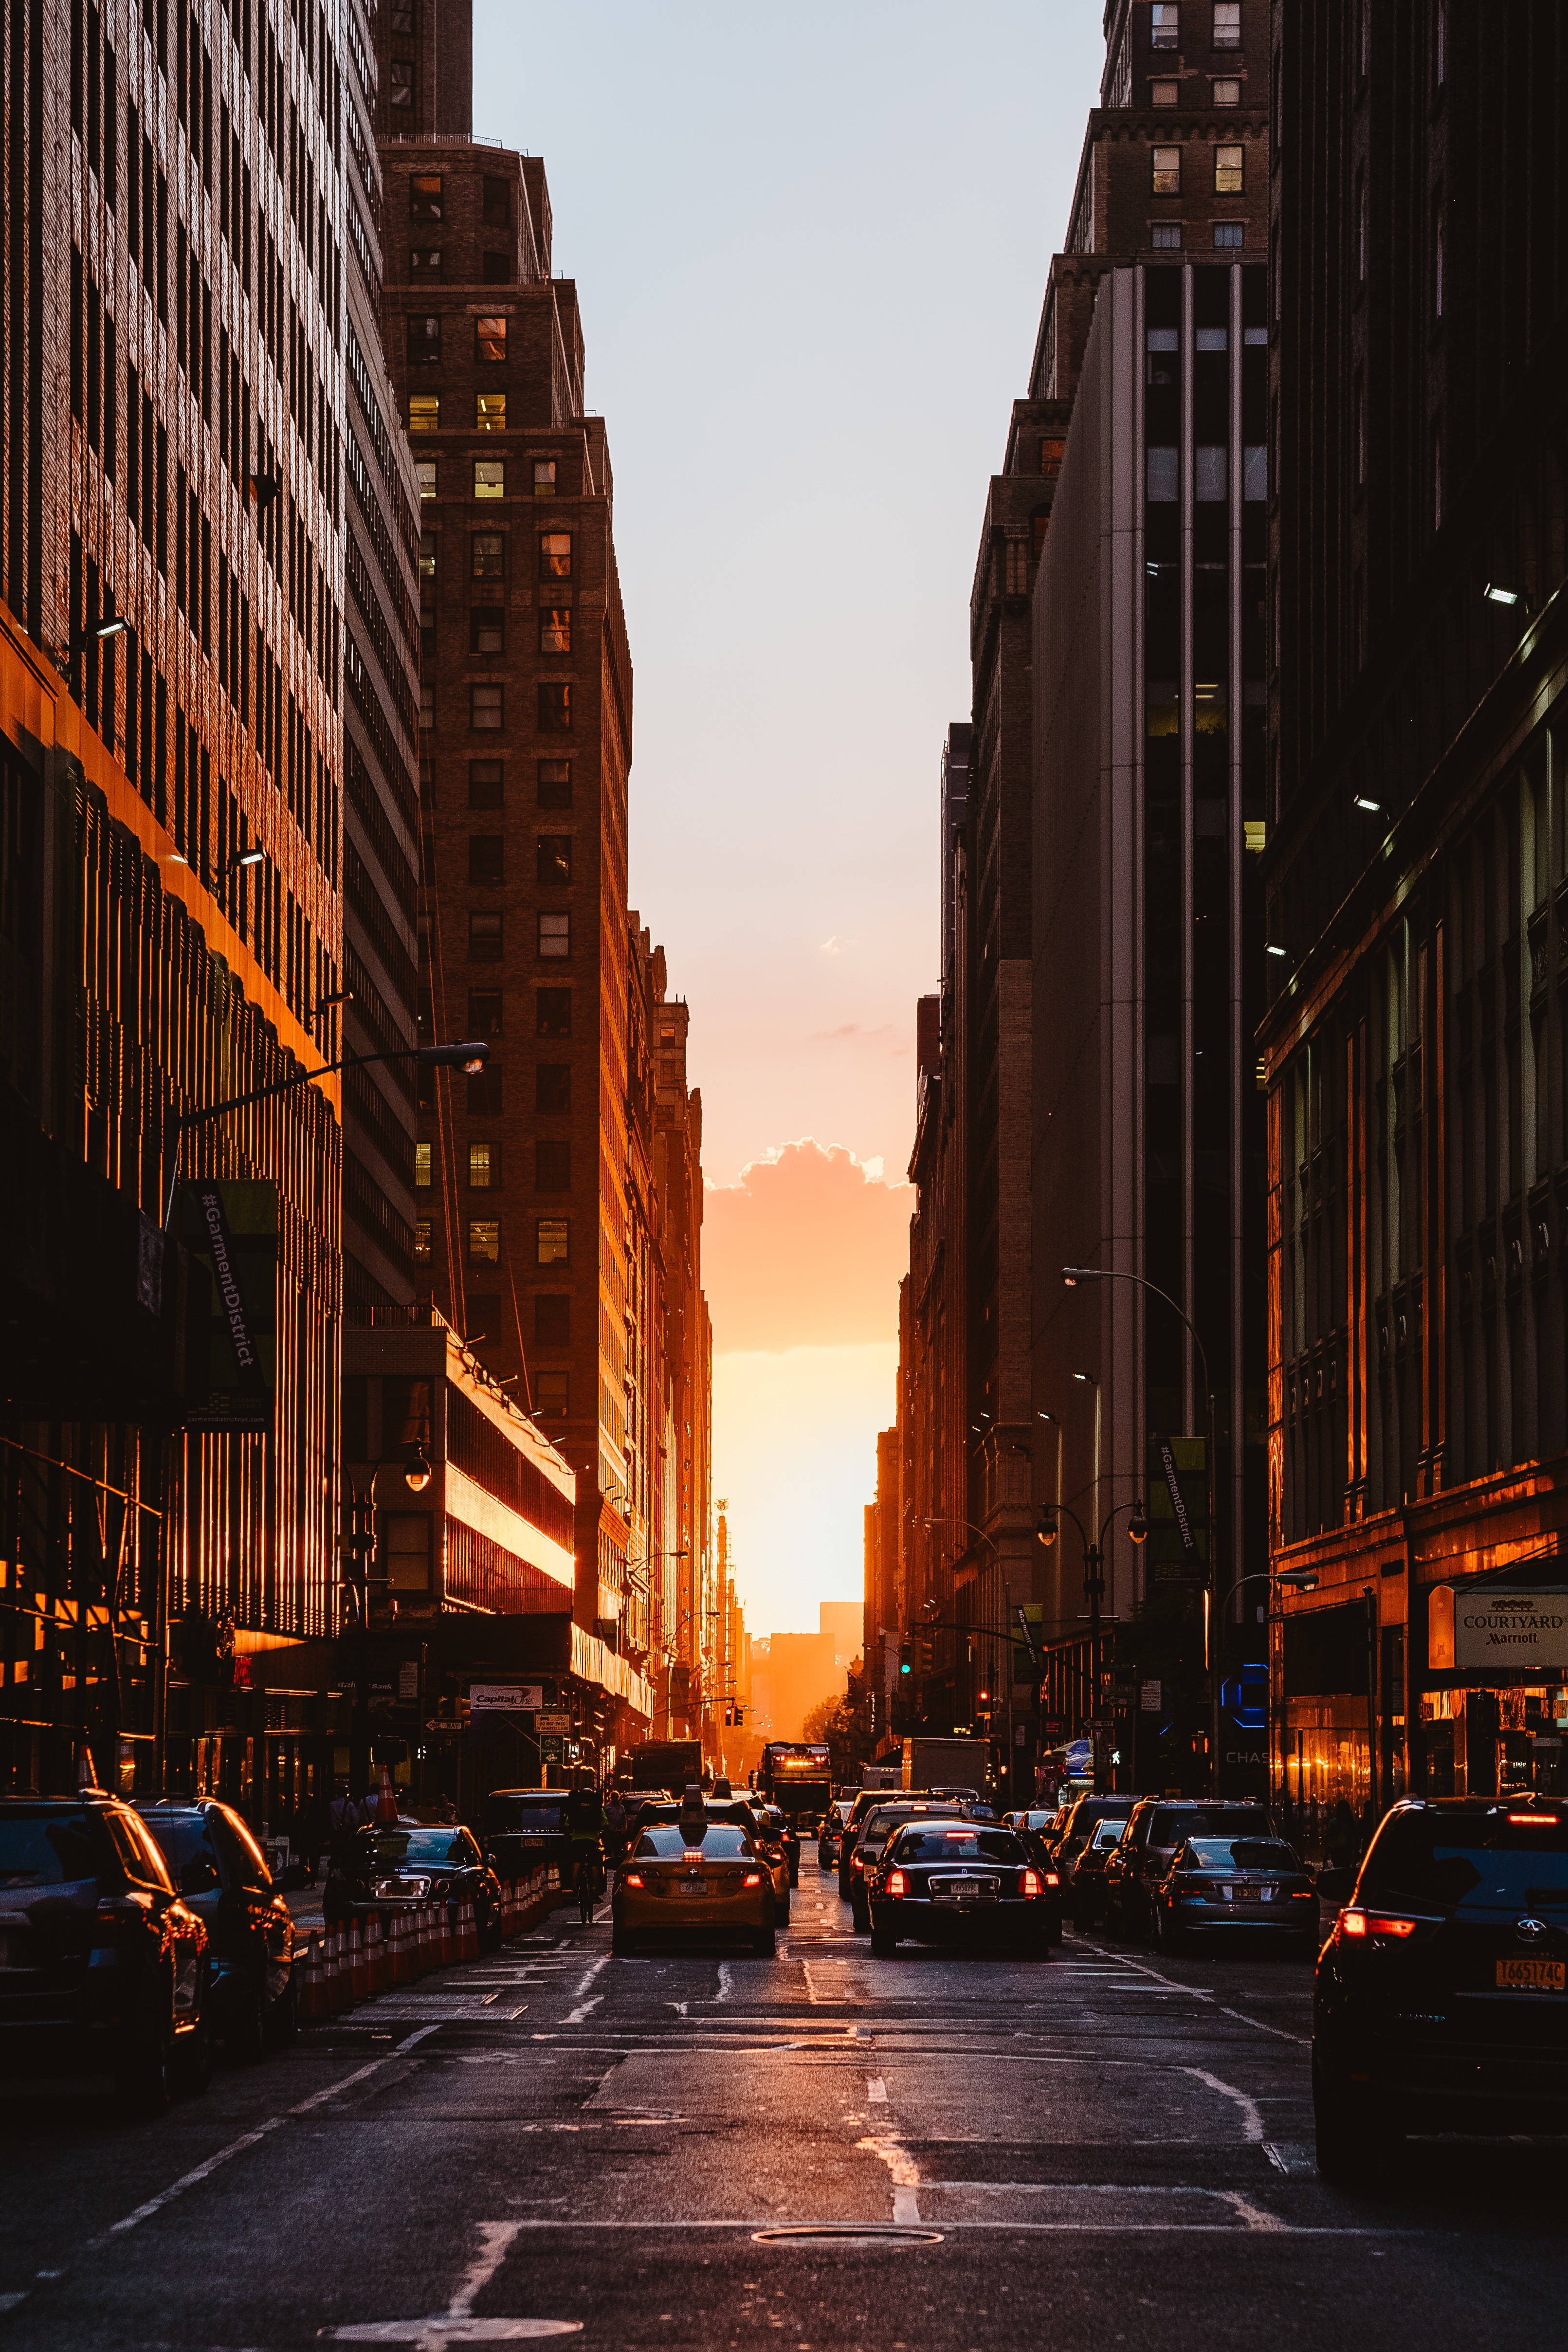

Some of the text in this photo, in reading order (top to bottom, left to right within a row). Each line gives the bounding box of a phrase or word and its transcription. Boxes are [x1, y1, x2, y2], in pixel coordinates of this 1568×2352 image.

[202, 1194, 254, 1367] #GarmentDistrict
[1160, 1446, 1193, 1549] #GarmentDistrict
[1464, 1616, 1563, 1628] COURTYARD
[1486, 1632, 1538, 1645] Marriott
[1226, 1752, 1269, 1764] CHAS
[1501, 1961, 1562, 1982] T665174C
